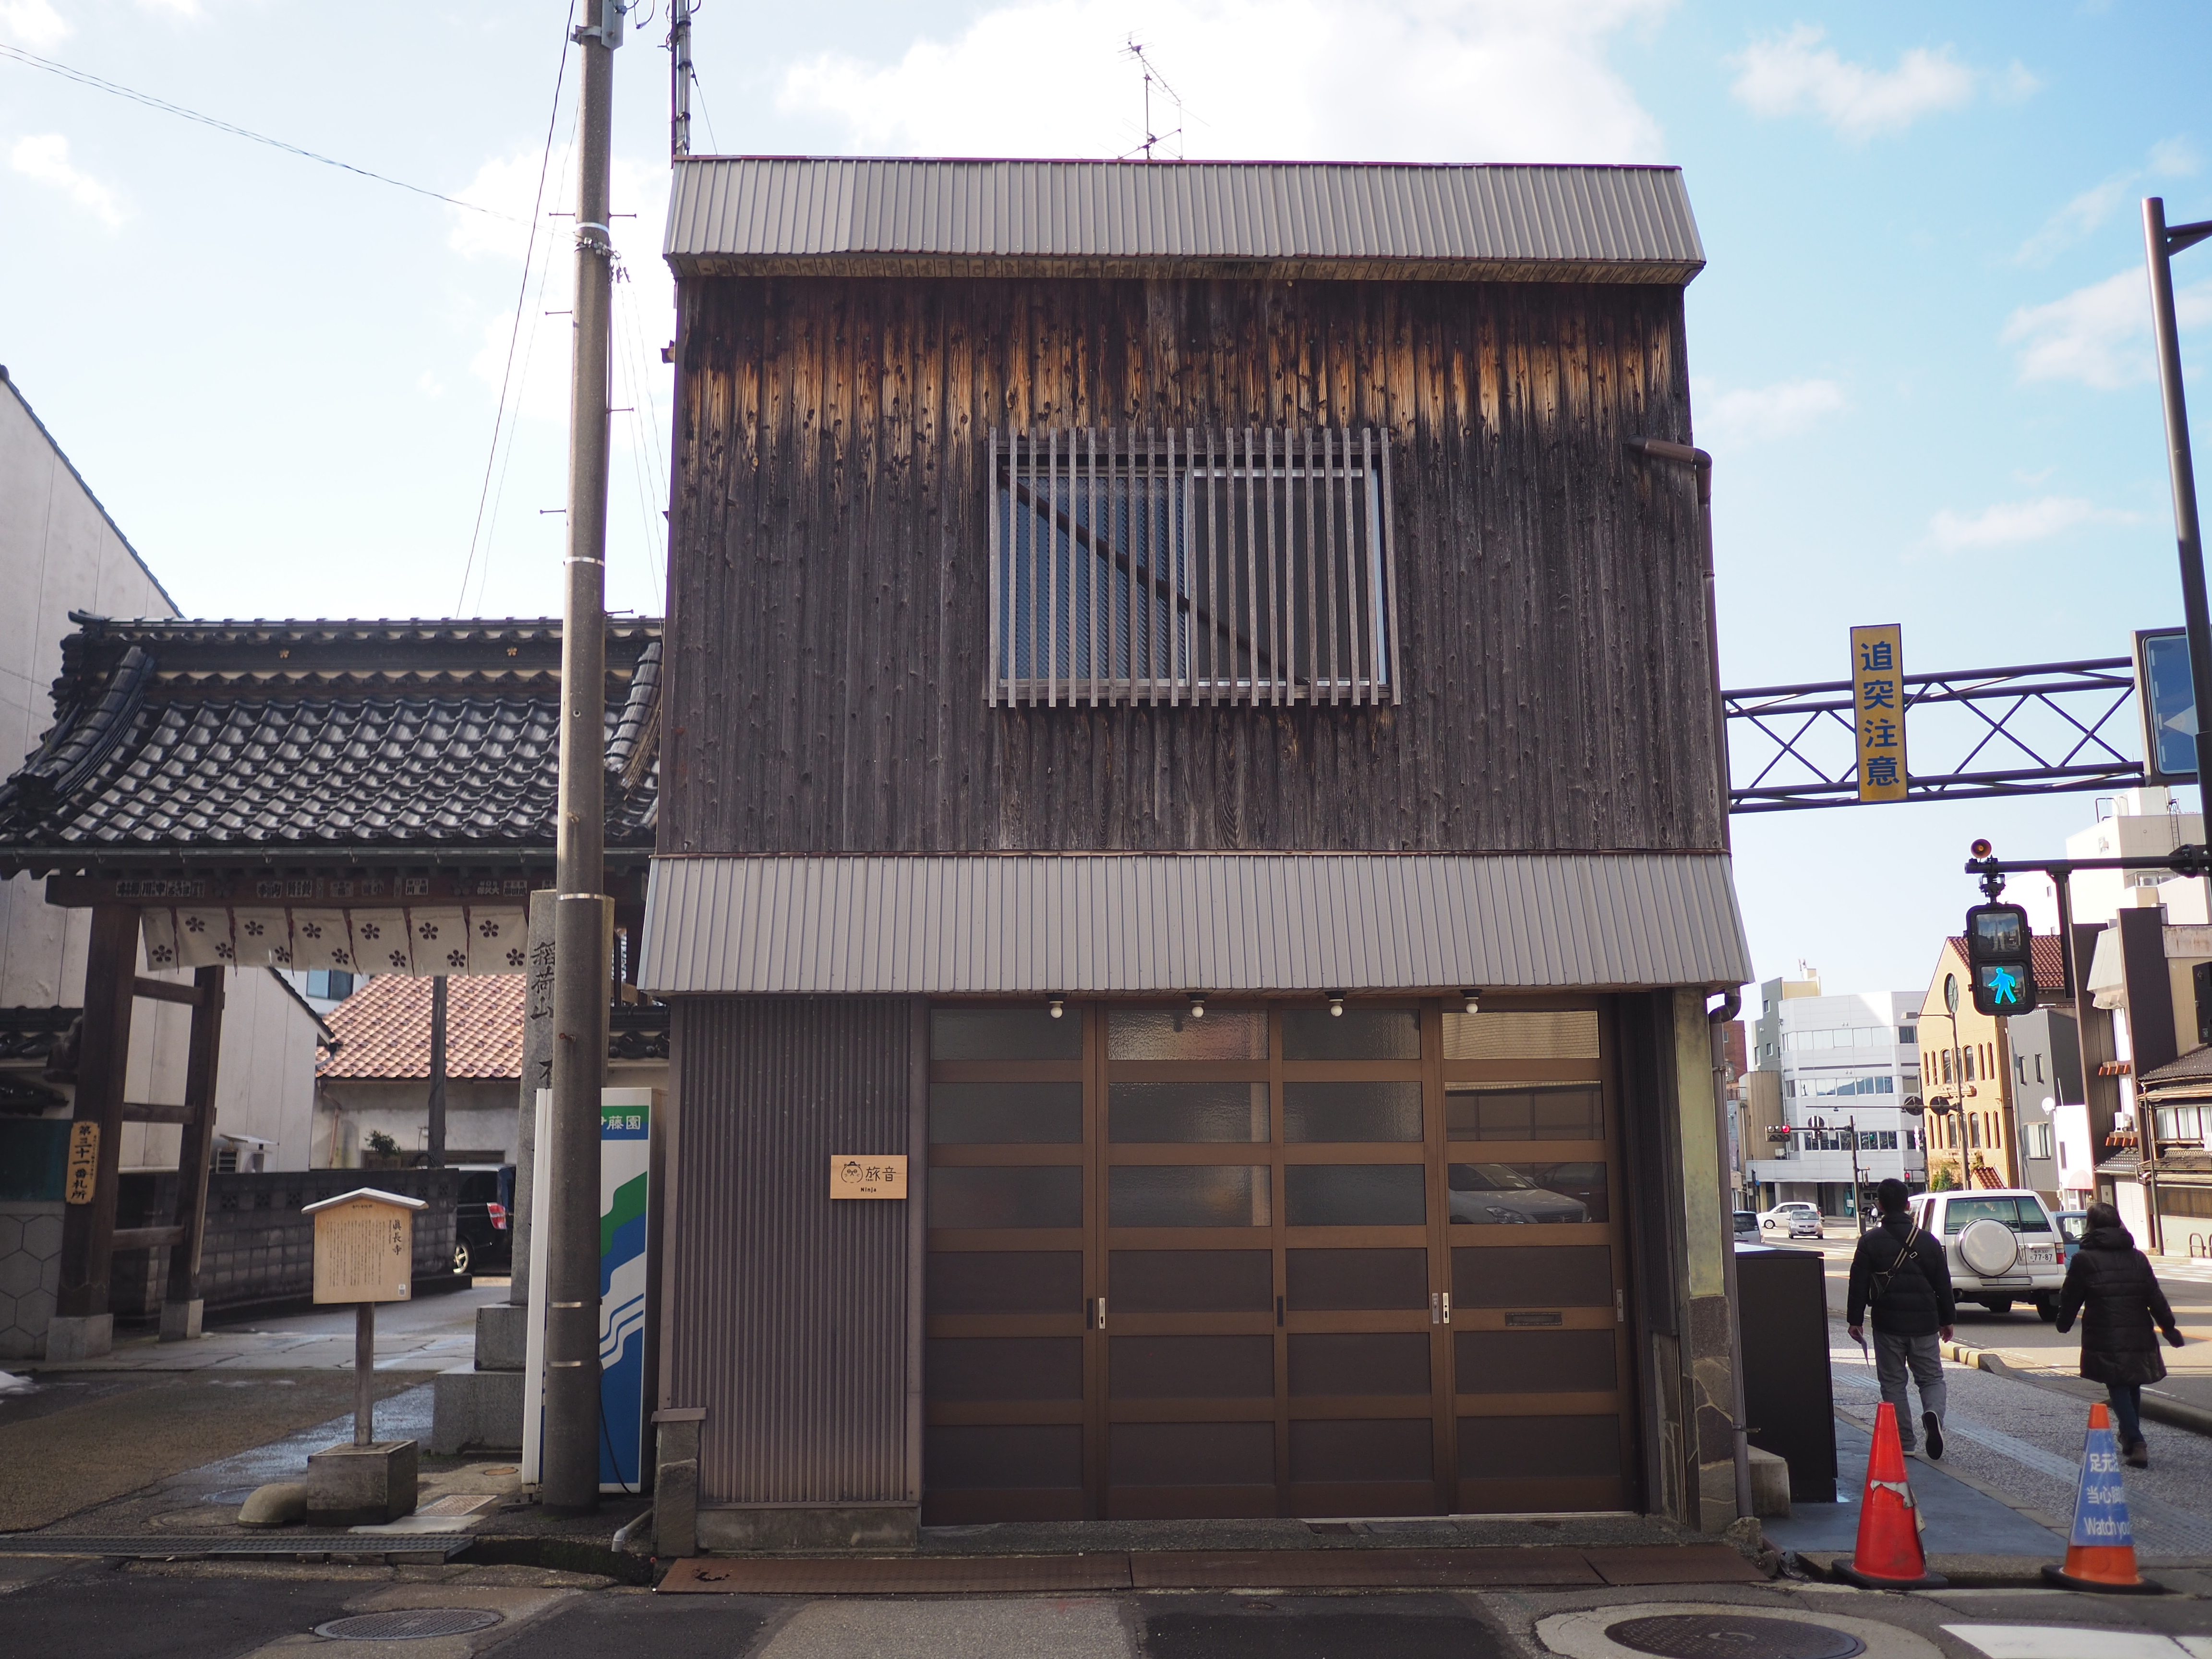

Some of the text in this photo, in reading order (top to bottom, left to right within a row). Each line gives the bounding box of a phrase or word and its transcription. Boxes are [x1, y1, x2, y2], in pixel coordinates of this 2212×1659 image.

[1861, 641, 1899, 787] 追突注意
[72, 1126, 92, 1200] 第三十一番札所
[866, 1166, 896, 1182] 旅音
[2083, 1515, 2117, 1536] Watch
